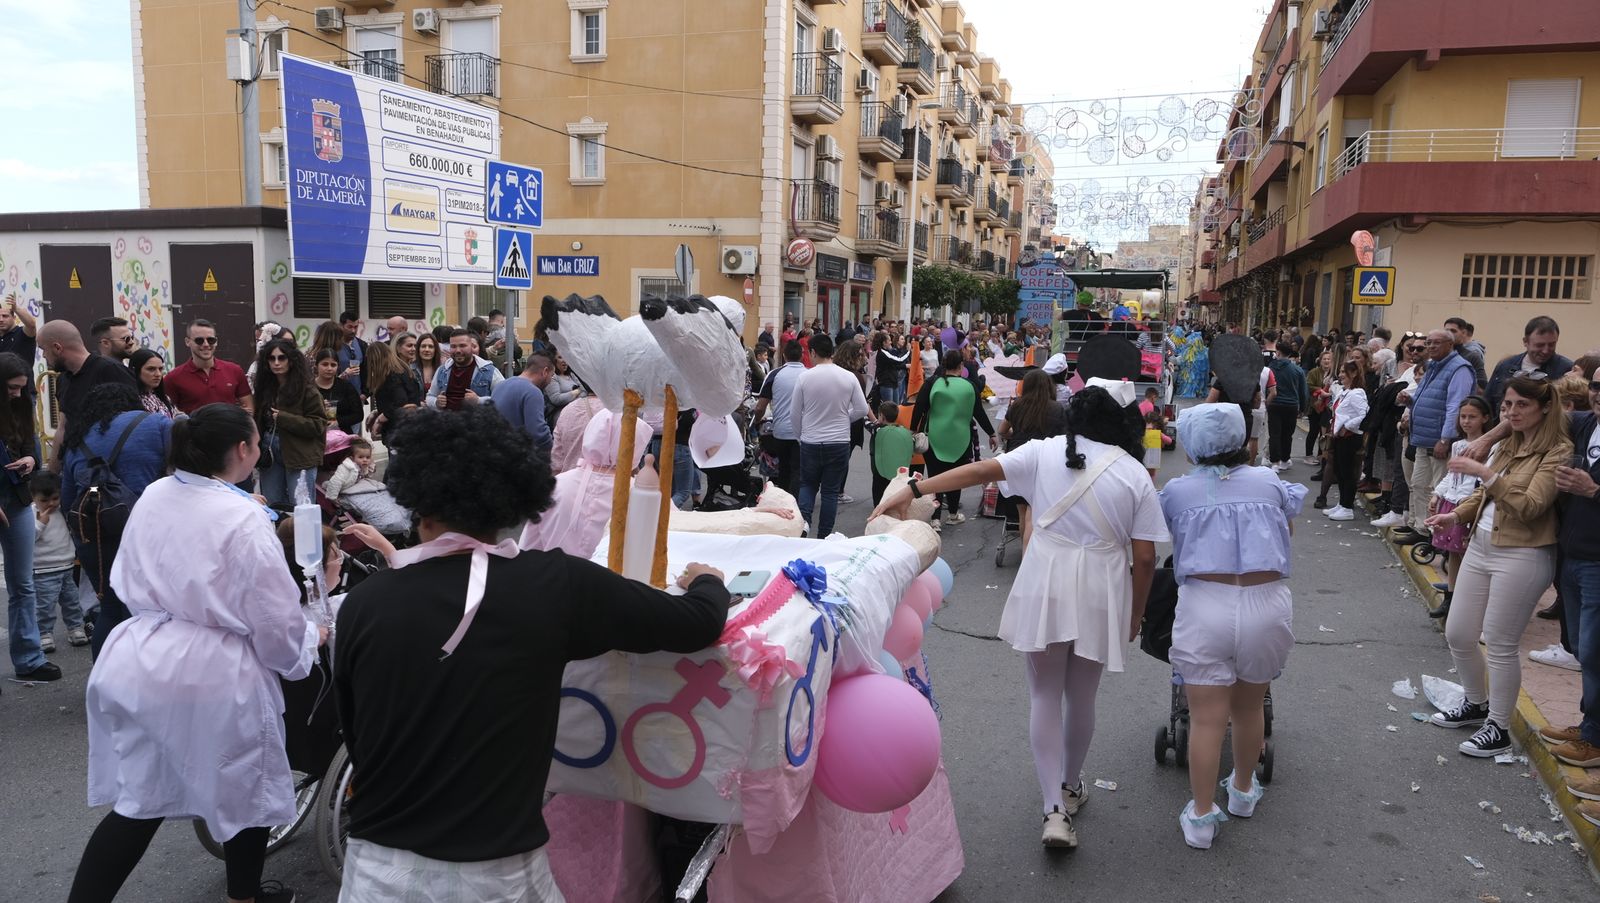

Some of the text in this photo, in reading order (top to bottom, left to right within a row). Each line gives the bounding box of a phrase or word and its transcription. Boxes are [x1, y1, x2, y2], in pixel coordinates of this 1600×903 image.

[434, 109, 485, 129] ABASTECIMIENTO
[485, 122, 491, 130] Y
[438, 121, 446, 130] DE
[416, 125, 464, 144] EN BENAHADUX
[409, 152, 473, 178] 660.000,00 €
[296, 168, 366, 191] DIPUTACIÓN
[297, 185, 366, 207] DE ALMERÍA
[402, 208, 436, 221] MAYGAR
[388, 253, 441, 265] SEPTIEMBRE 2019
[573, 257, 595, 274] CRUZ
[1020, 277, 1069, 287] CREPES
